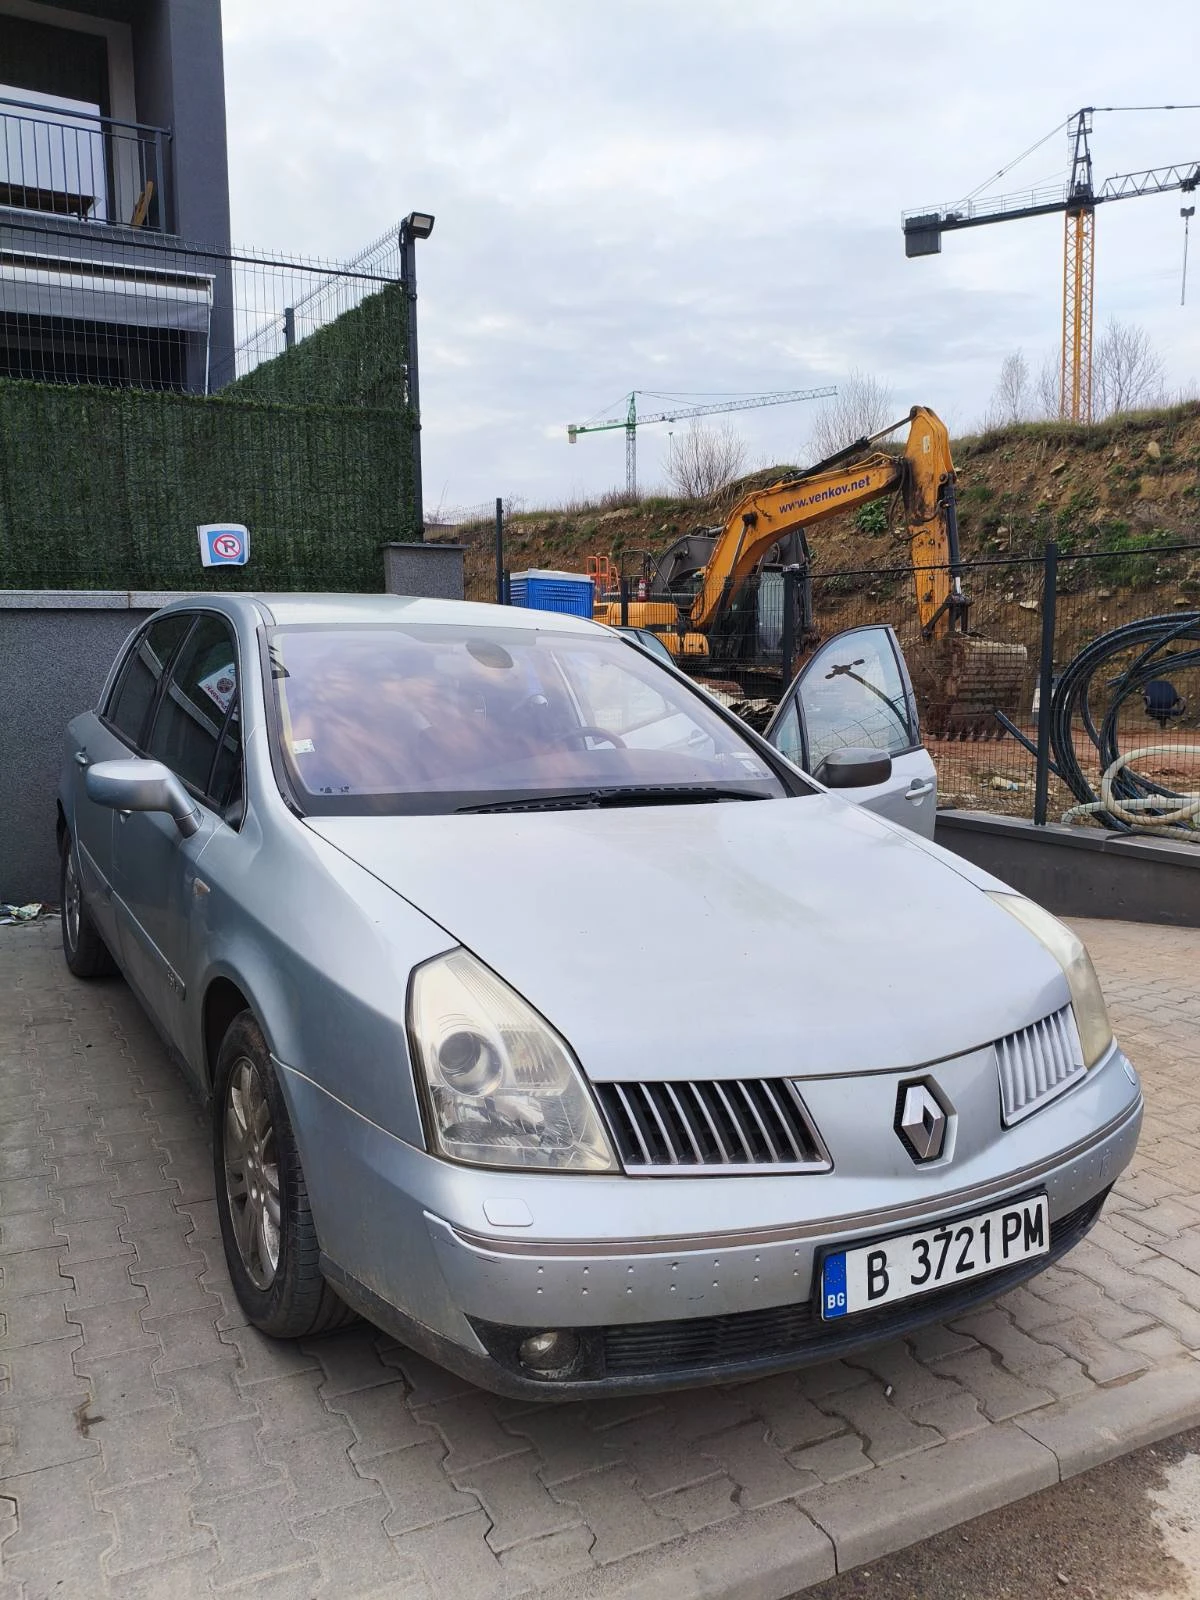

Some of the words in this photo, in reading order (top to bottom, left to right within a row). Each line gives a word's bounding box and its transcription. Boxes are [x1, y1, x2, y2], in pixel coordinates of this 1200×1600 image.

[779, 475, 870, 513] www.venkov.net
[867, 1249, 890, 1301] B
[911, 1219, 991, 1286] 3721
[1002, 1203, 1044, 1259] PM
[827, 1293, 845, 1309] BG
